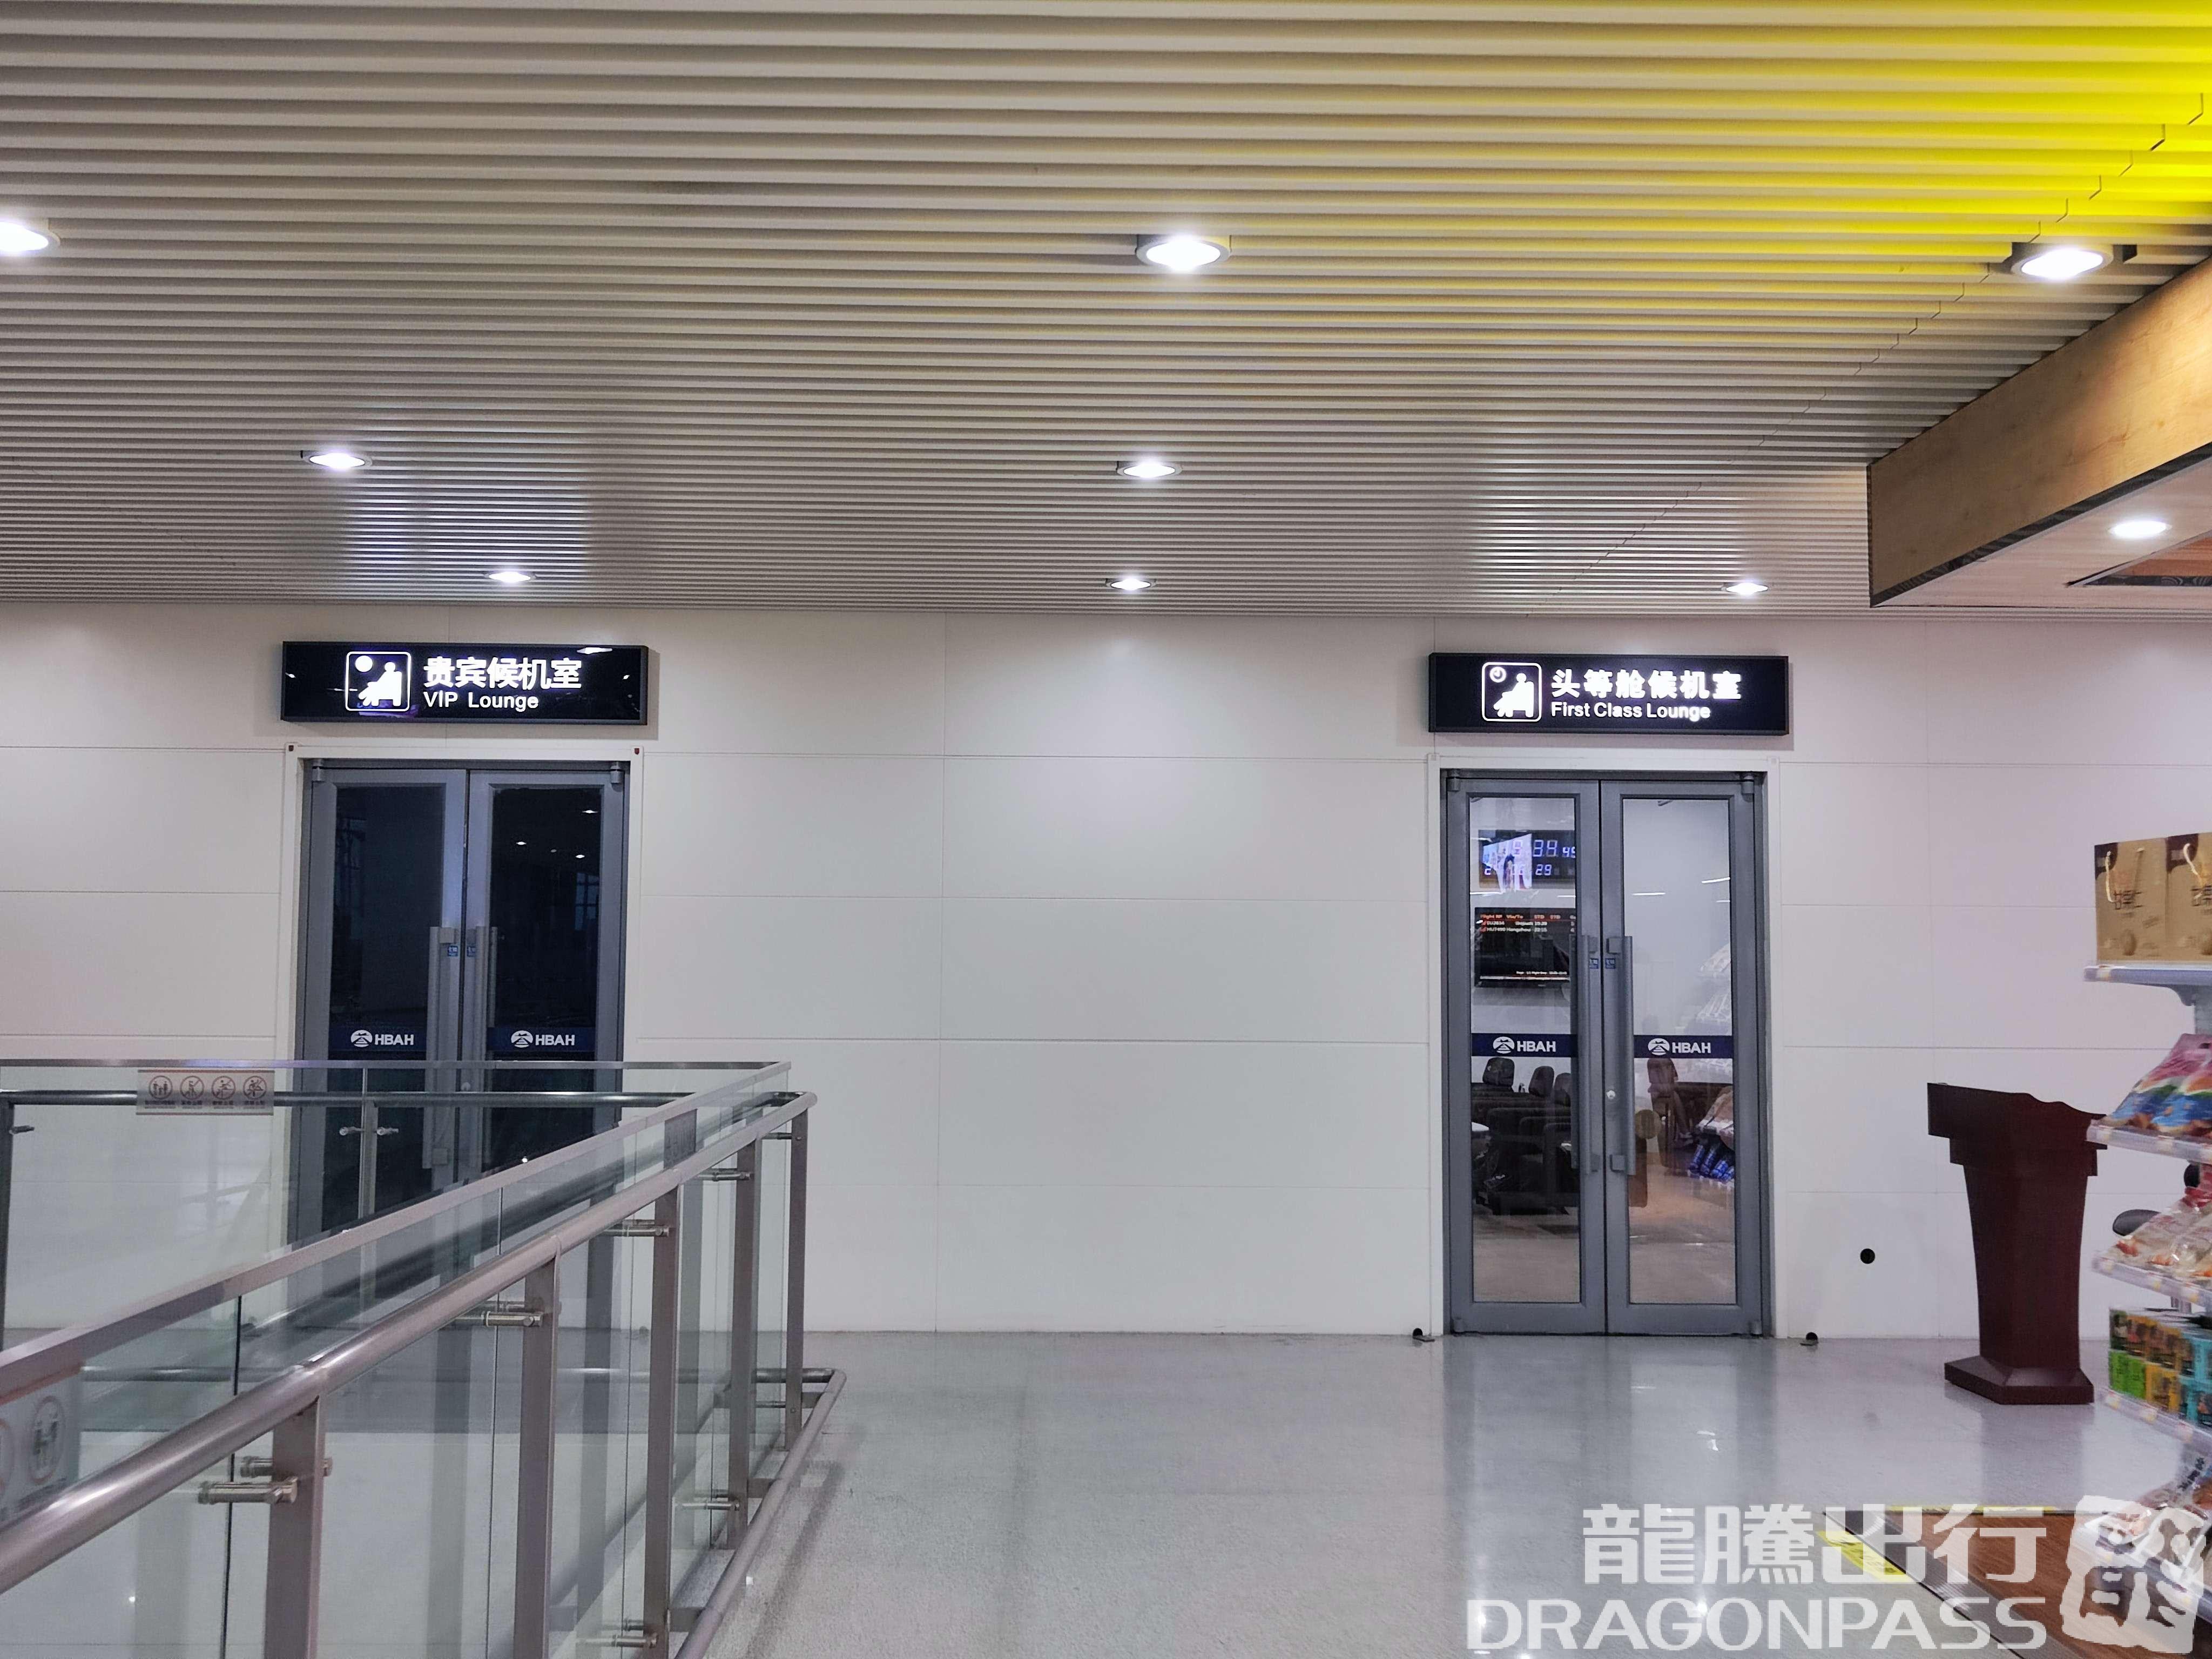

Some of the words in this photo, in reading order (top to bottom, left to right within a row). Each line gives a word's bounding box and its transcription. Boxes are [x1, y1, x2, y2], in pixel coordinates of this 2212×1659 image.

[423, 657, 582, 689] 贵宾候机室
[1551, 669, 1741, 699] 头等舱候机室
[423, 691, 458, 707] VIP
[468, 692, 539, 712] Lounge
[1551, 702, 1590, 717] First
[1594, 702, 1643, 718] Class
[1647, 703, 1711, 722] Lounge
[374, 1034, 414, 1046] HBAH
[535, 1034, 575, 1046] HBAH
[1516, 1041, 1556, 1052] HBAH
[1672, 1042, 1711, 1054] HBAH
